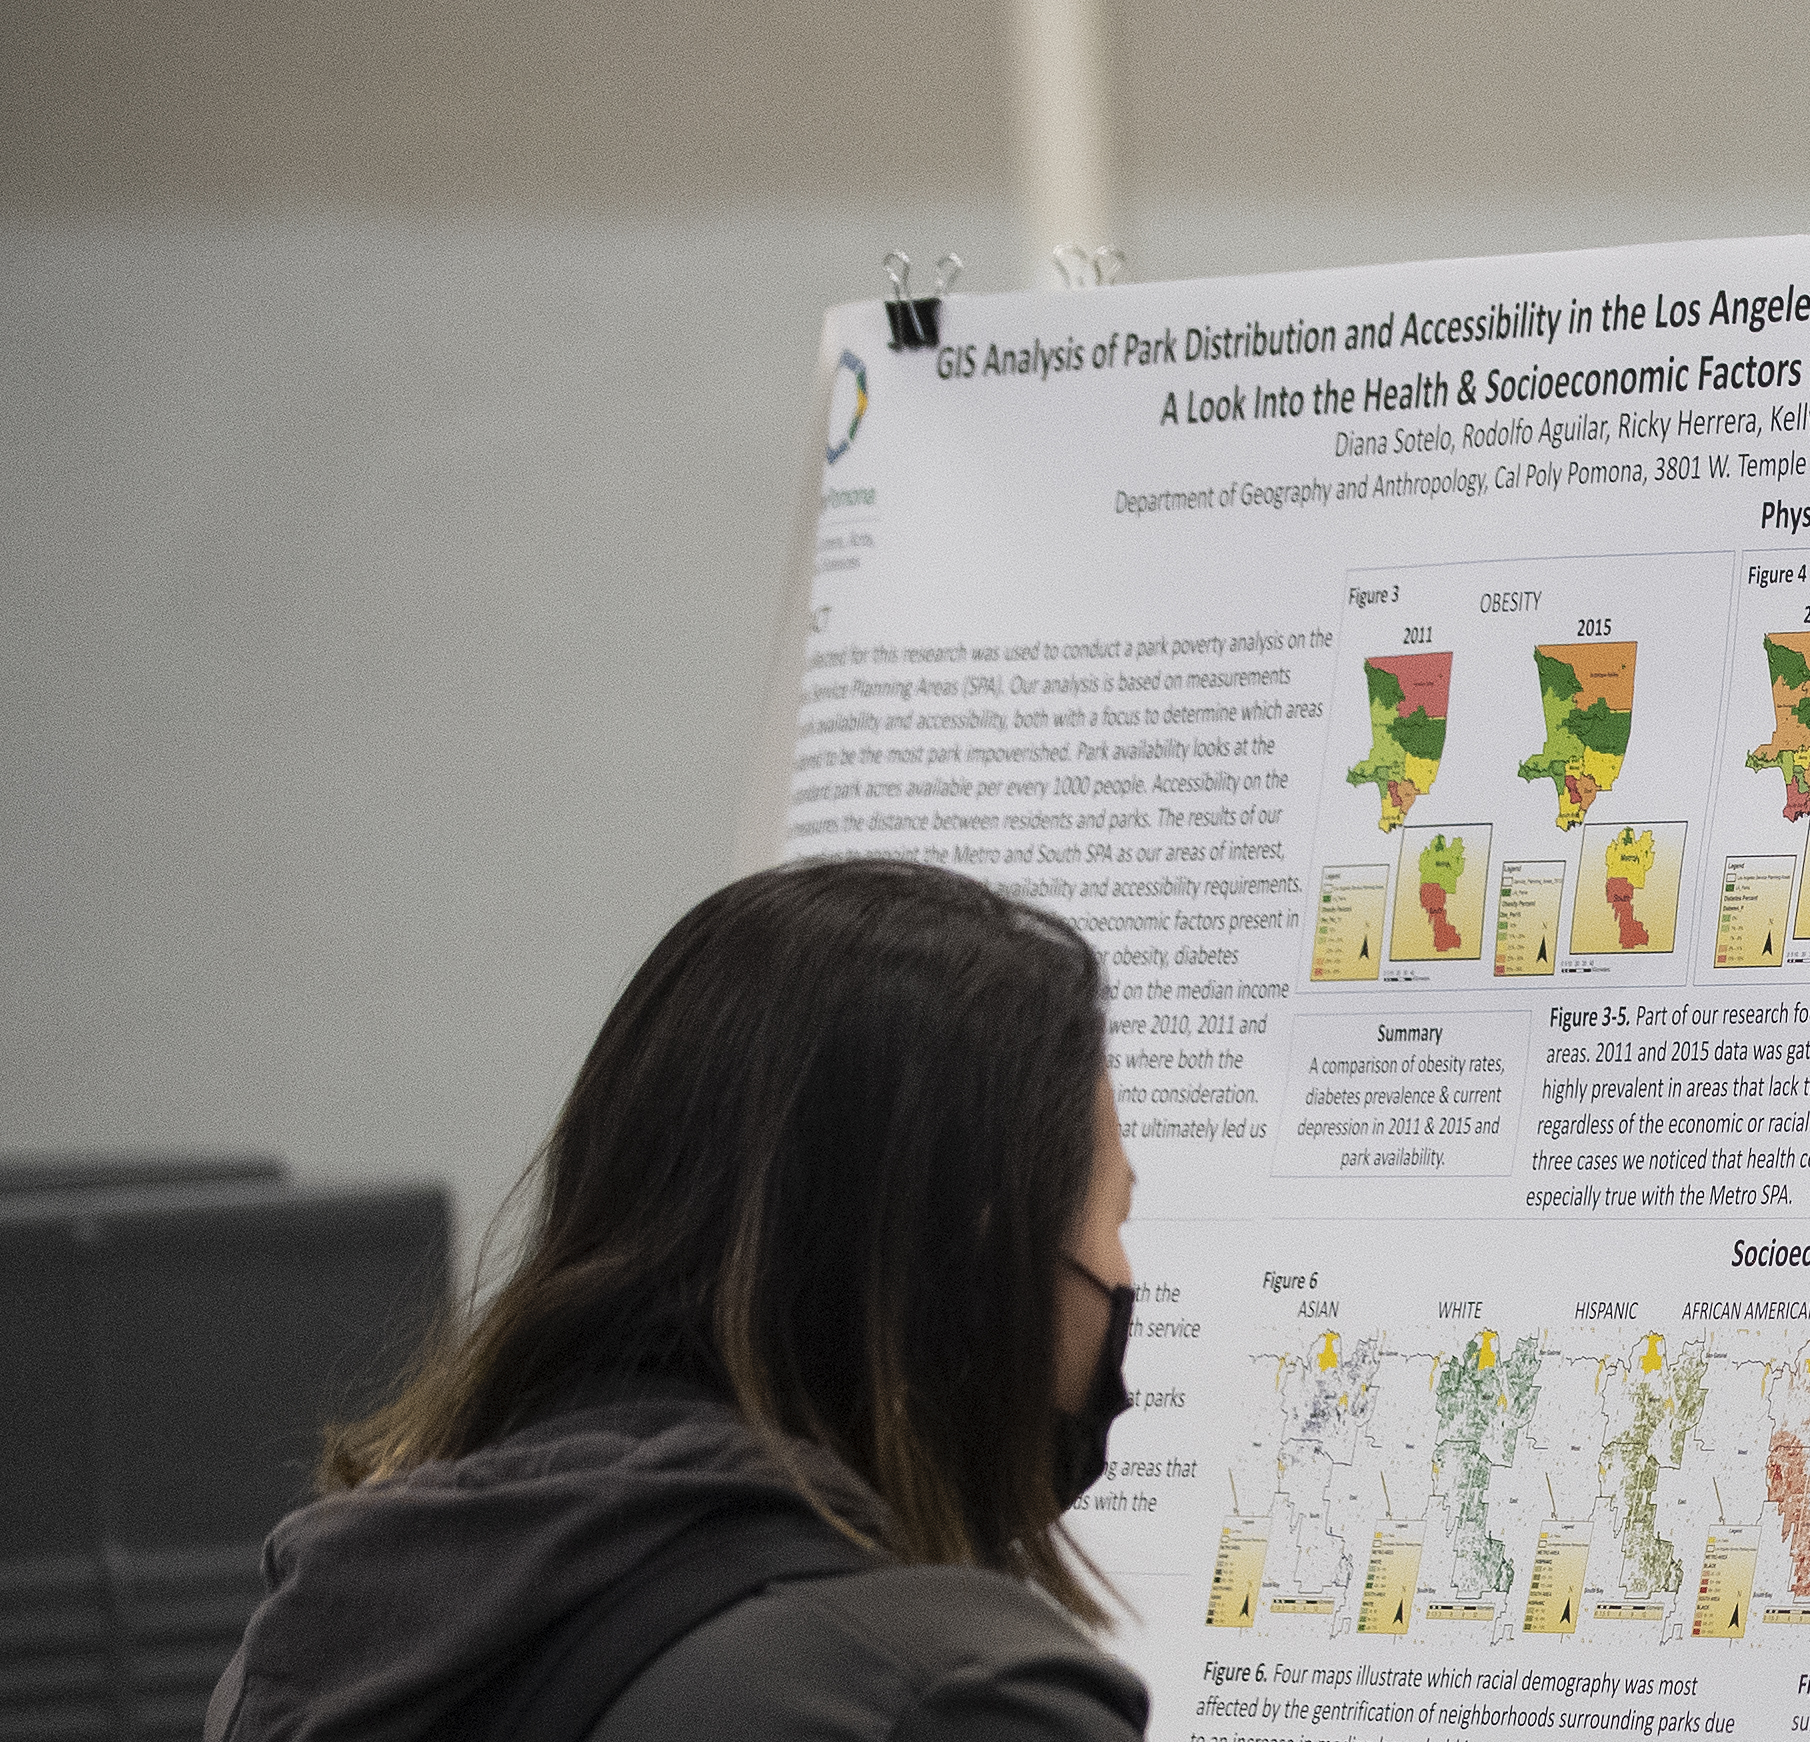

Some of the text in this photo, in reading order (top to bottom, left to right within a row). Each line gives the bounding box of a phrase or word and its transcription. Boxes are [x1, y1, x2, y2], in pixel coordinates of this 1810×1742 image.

[936, 343, 977, 380] GIS
[983, 340, 1084, 379] Analysis
[1091, 332, 1118, 369] of
[1124, 329, 1176, 366] Park
[1184, 321, 1337, 362] Distribution
[1343, 312, 1395, 352] and
[1400, 301, 1562, 347] Accessibility
[1568, 298, 1594, 333] in
[1601, 294, 1647, 333] the
[1654, 293, 1701, 329] Los
[1161, 392, 1179, 424] A
[1187, 386, 1245, 425] Look
[1254, 386, 1305, 419] Into
[1312, 379, 1356, 416] the
[1363, 371, 1449, 412] Health
[1456, 368, 1477, 407] &
[1484, 356, 1690, 404] Socioeconomic
[1698, 354, 1802, 391] Factors
[1334, 431, 1388, 458] Diana
[1393, 424, 1455, 454] Sotelo,
[1462, 417, 1534, 449] Rodolfo
[1537, 413, 1611, 450] Aguilar,
[1617, 410, 1672, 443] Ricky
[1676, 409, 1763, 437] Herrera,
[1747, 564, 1807, 589] Figure 4
[1348, 584, 1400, 609] Figure 3
[1479, 590, 1542, 614] OBESITY
[1402, 626, 1433, 645] 2011
[1576, 617, 1612, 637] 2015
[1377, 1023, 1443, 1046] Summary
[1262, 1270, 1319, 1295] Figure 6
[1297, 1300, 1340, 1318] ASIAN
[1438, 1301, 1483, 1319] WHITE
[1575, 1302, 1639, 1320] HISPANIC
[1681, 1302, 1742, 1320] AFRICAN
